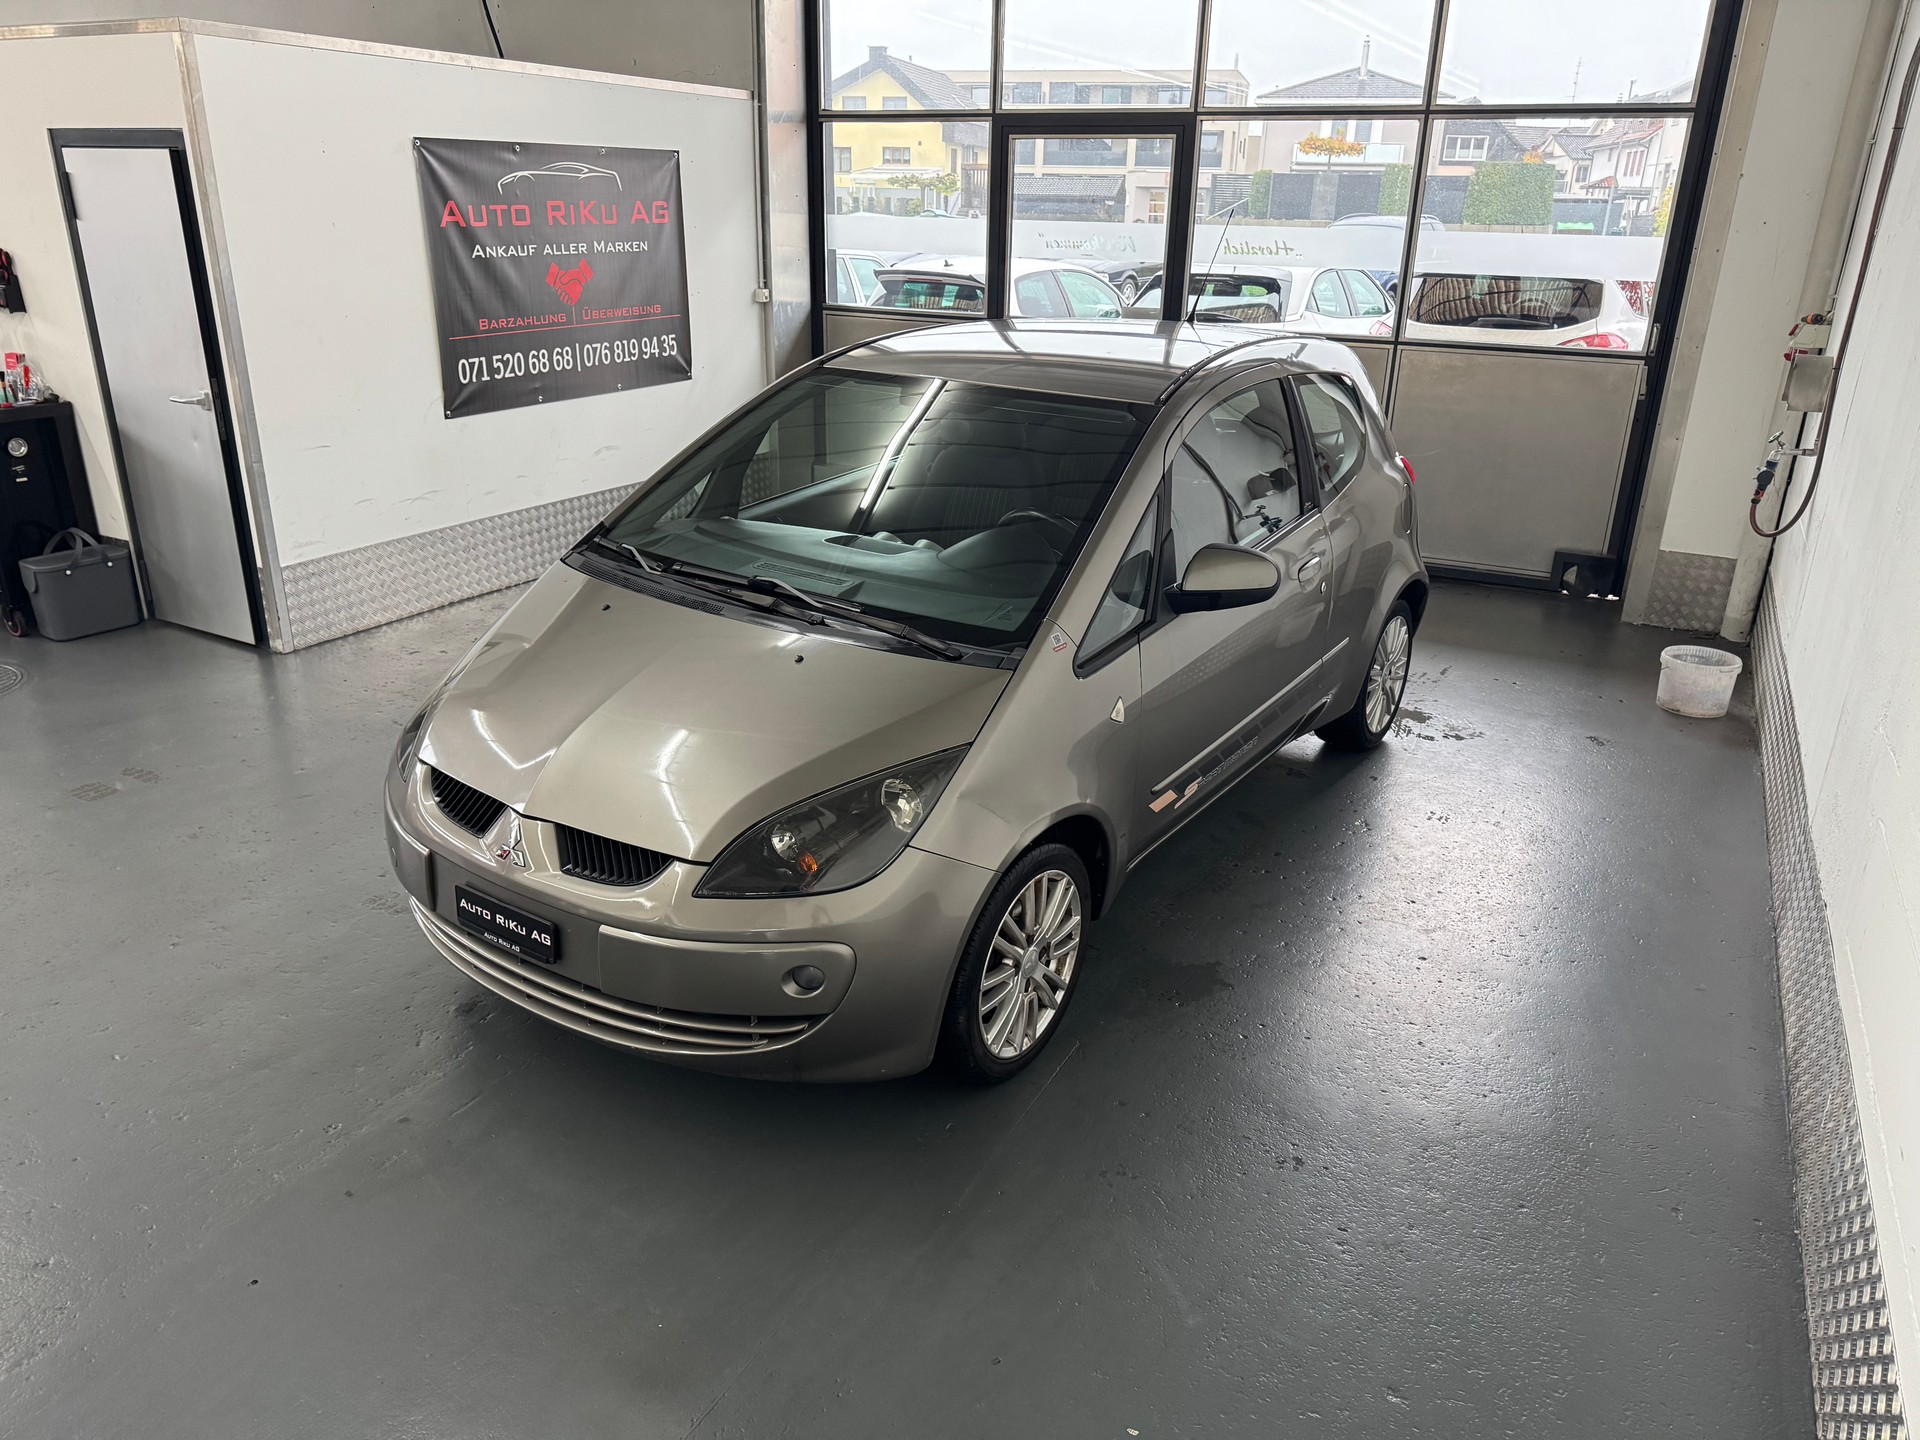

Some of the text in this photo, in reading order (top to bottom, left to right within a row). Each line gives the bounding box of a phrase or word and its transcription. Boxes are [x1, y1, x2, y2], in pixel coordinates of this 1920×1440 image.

[631, 200, 669, 225] AG
[457, 356, 491, 385] 071
[493, 352, 525, 380] 520
[528, 349, 549, 374] 68
[552, 346, 573, 372] 68
[583, 342, 611, 368] 076
[614, 338, 638, 363] 819
[641, 335, 659, 360] 94
[661, 333, 678, 358] 35
[531, 930, 551, 946] AG
